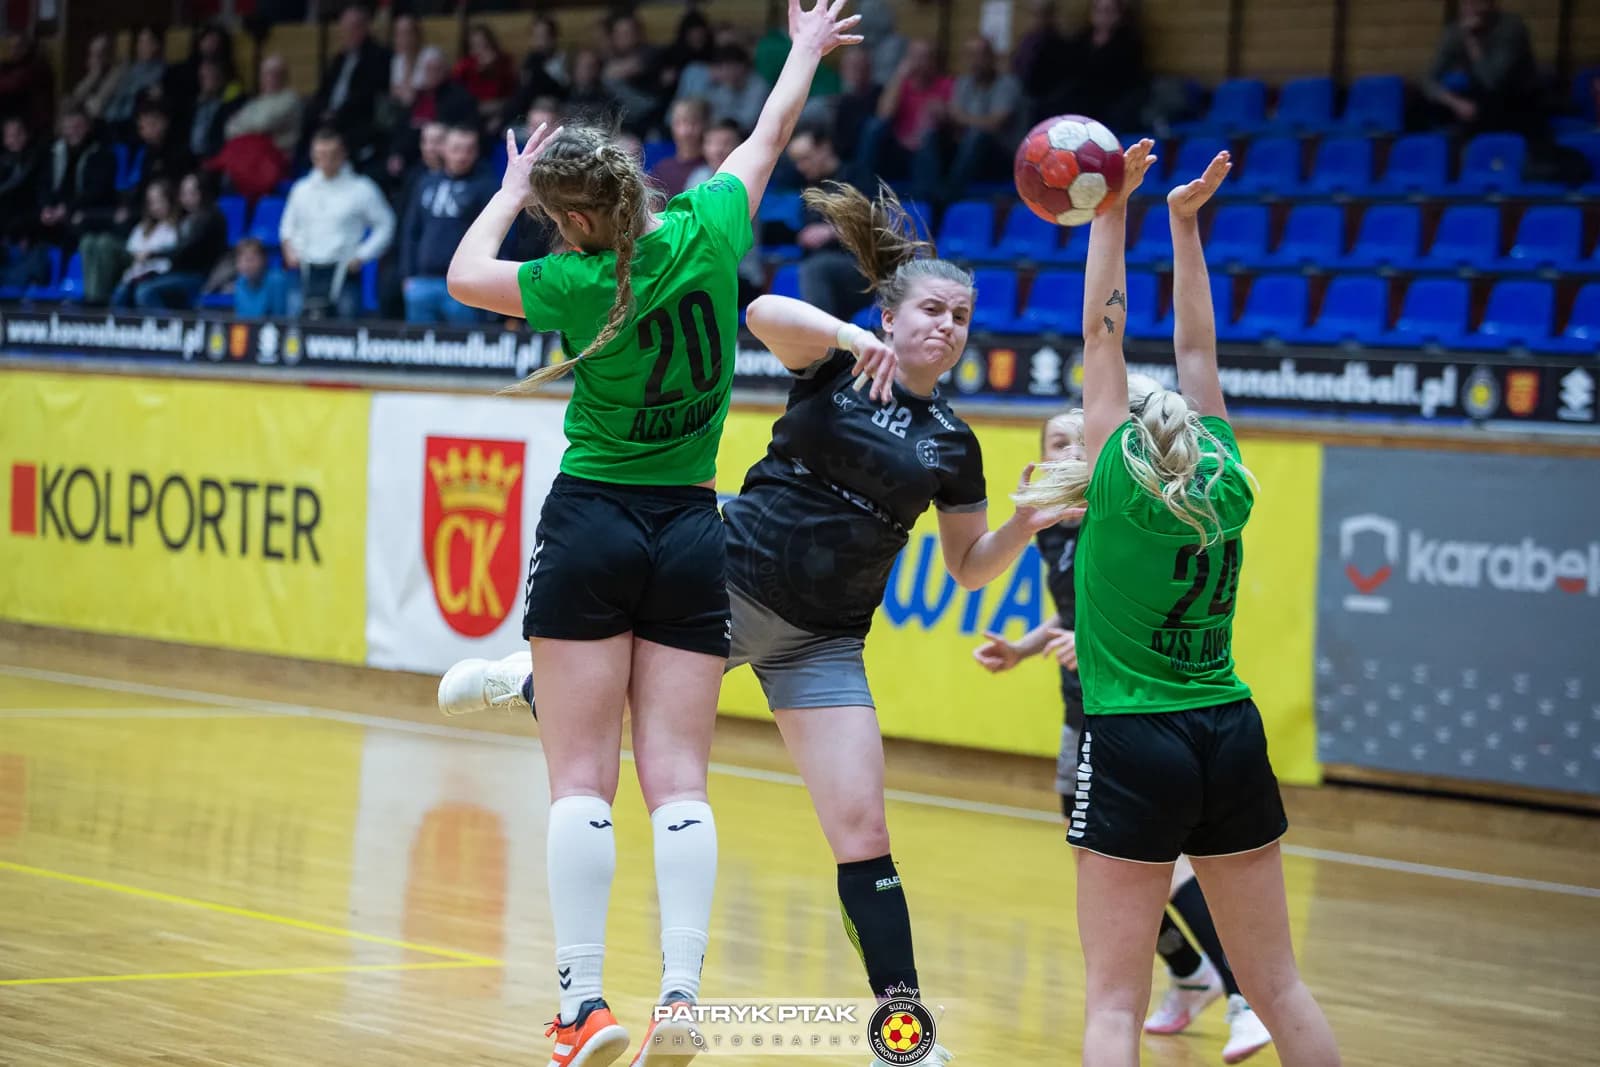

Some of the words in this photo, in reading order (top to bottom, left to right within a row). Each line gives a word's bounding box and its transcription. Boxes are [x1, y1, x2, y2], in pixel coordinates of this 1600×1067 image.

[637, 289, 722, 407] 20
[629, 408, 675, 440] AZS
[40, 462, 322, 565] KOLPORTER
[433, 512, 505, 619] CK
[1161, 538, 1238, 629] 24
